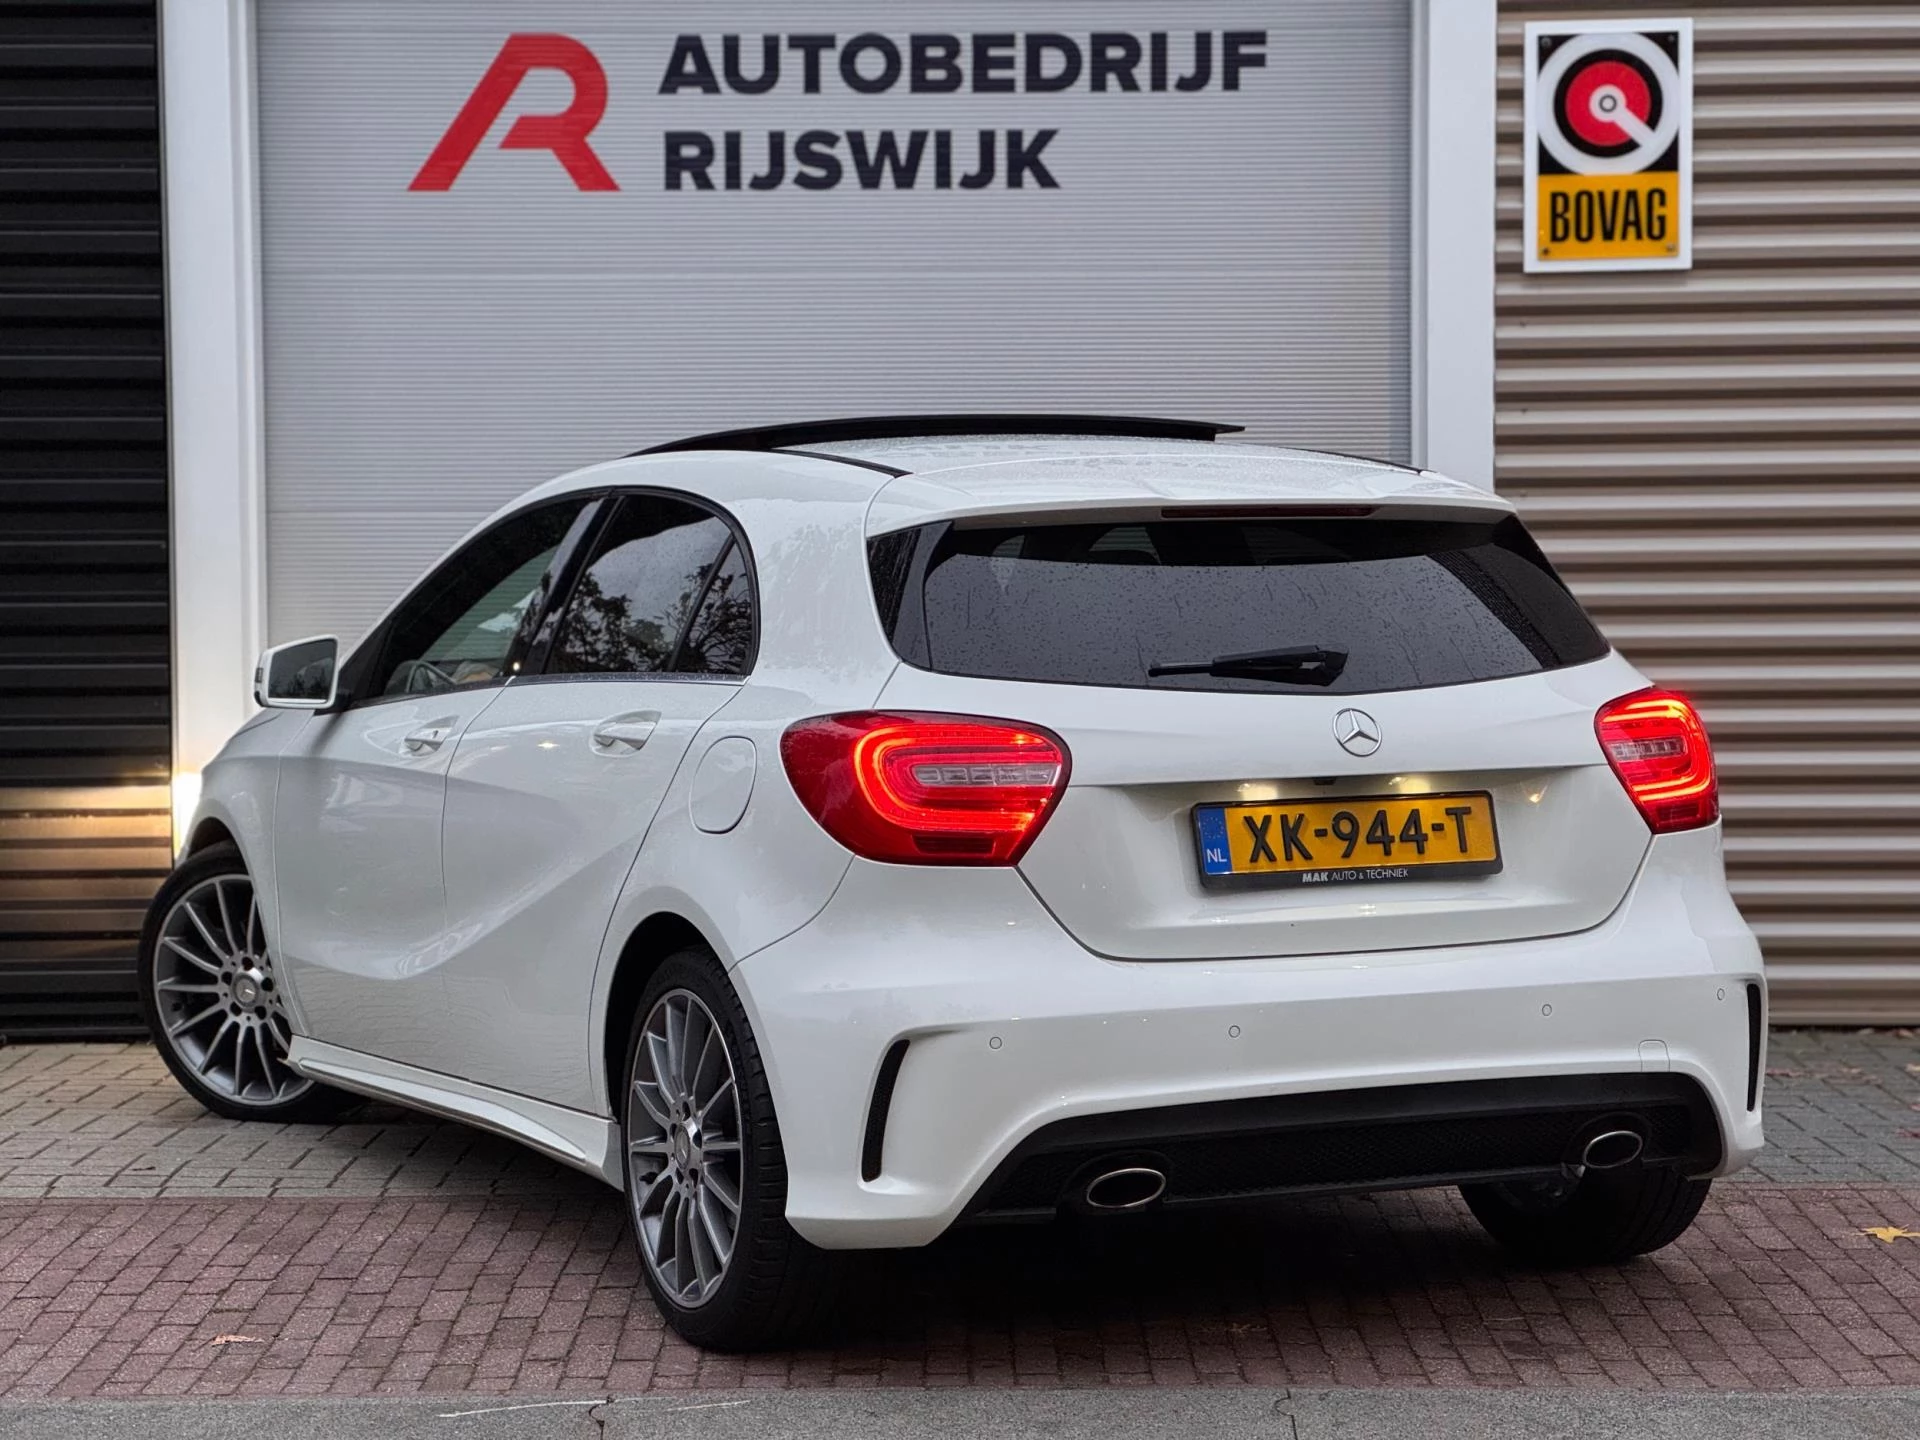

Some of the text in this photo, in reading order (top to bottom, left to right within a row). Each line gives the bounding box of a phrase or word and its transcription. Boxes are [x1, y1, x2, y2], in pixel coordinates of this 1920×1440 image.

[658, 30, 1267, 94] AUTOBEDRIJF
[664, 130, 1060, 191] RIJSWIJK
[1550, 188, 1667, 242] BOVAG
[1207, 848, 1227, 863] NL
[1244, 806, 1471, 863] XK-944-T
[1302, 872, 1329, 882] MAK
[1331, 871, 1357, 881] AUTO
[1366, 868, 1409, 879] TECHNIEK
